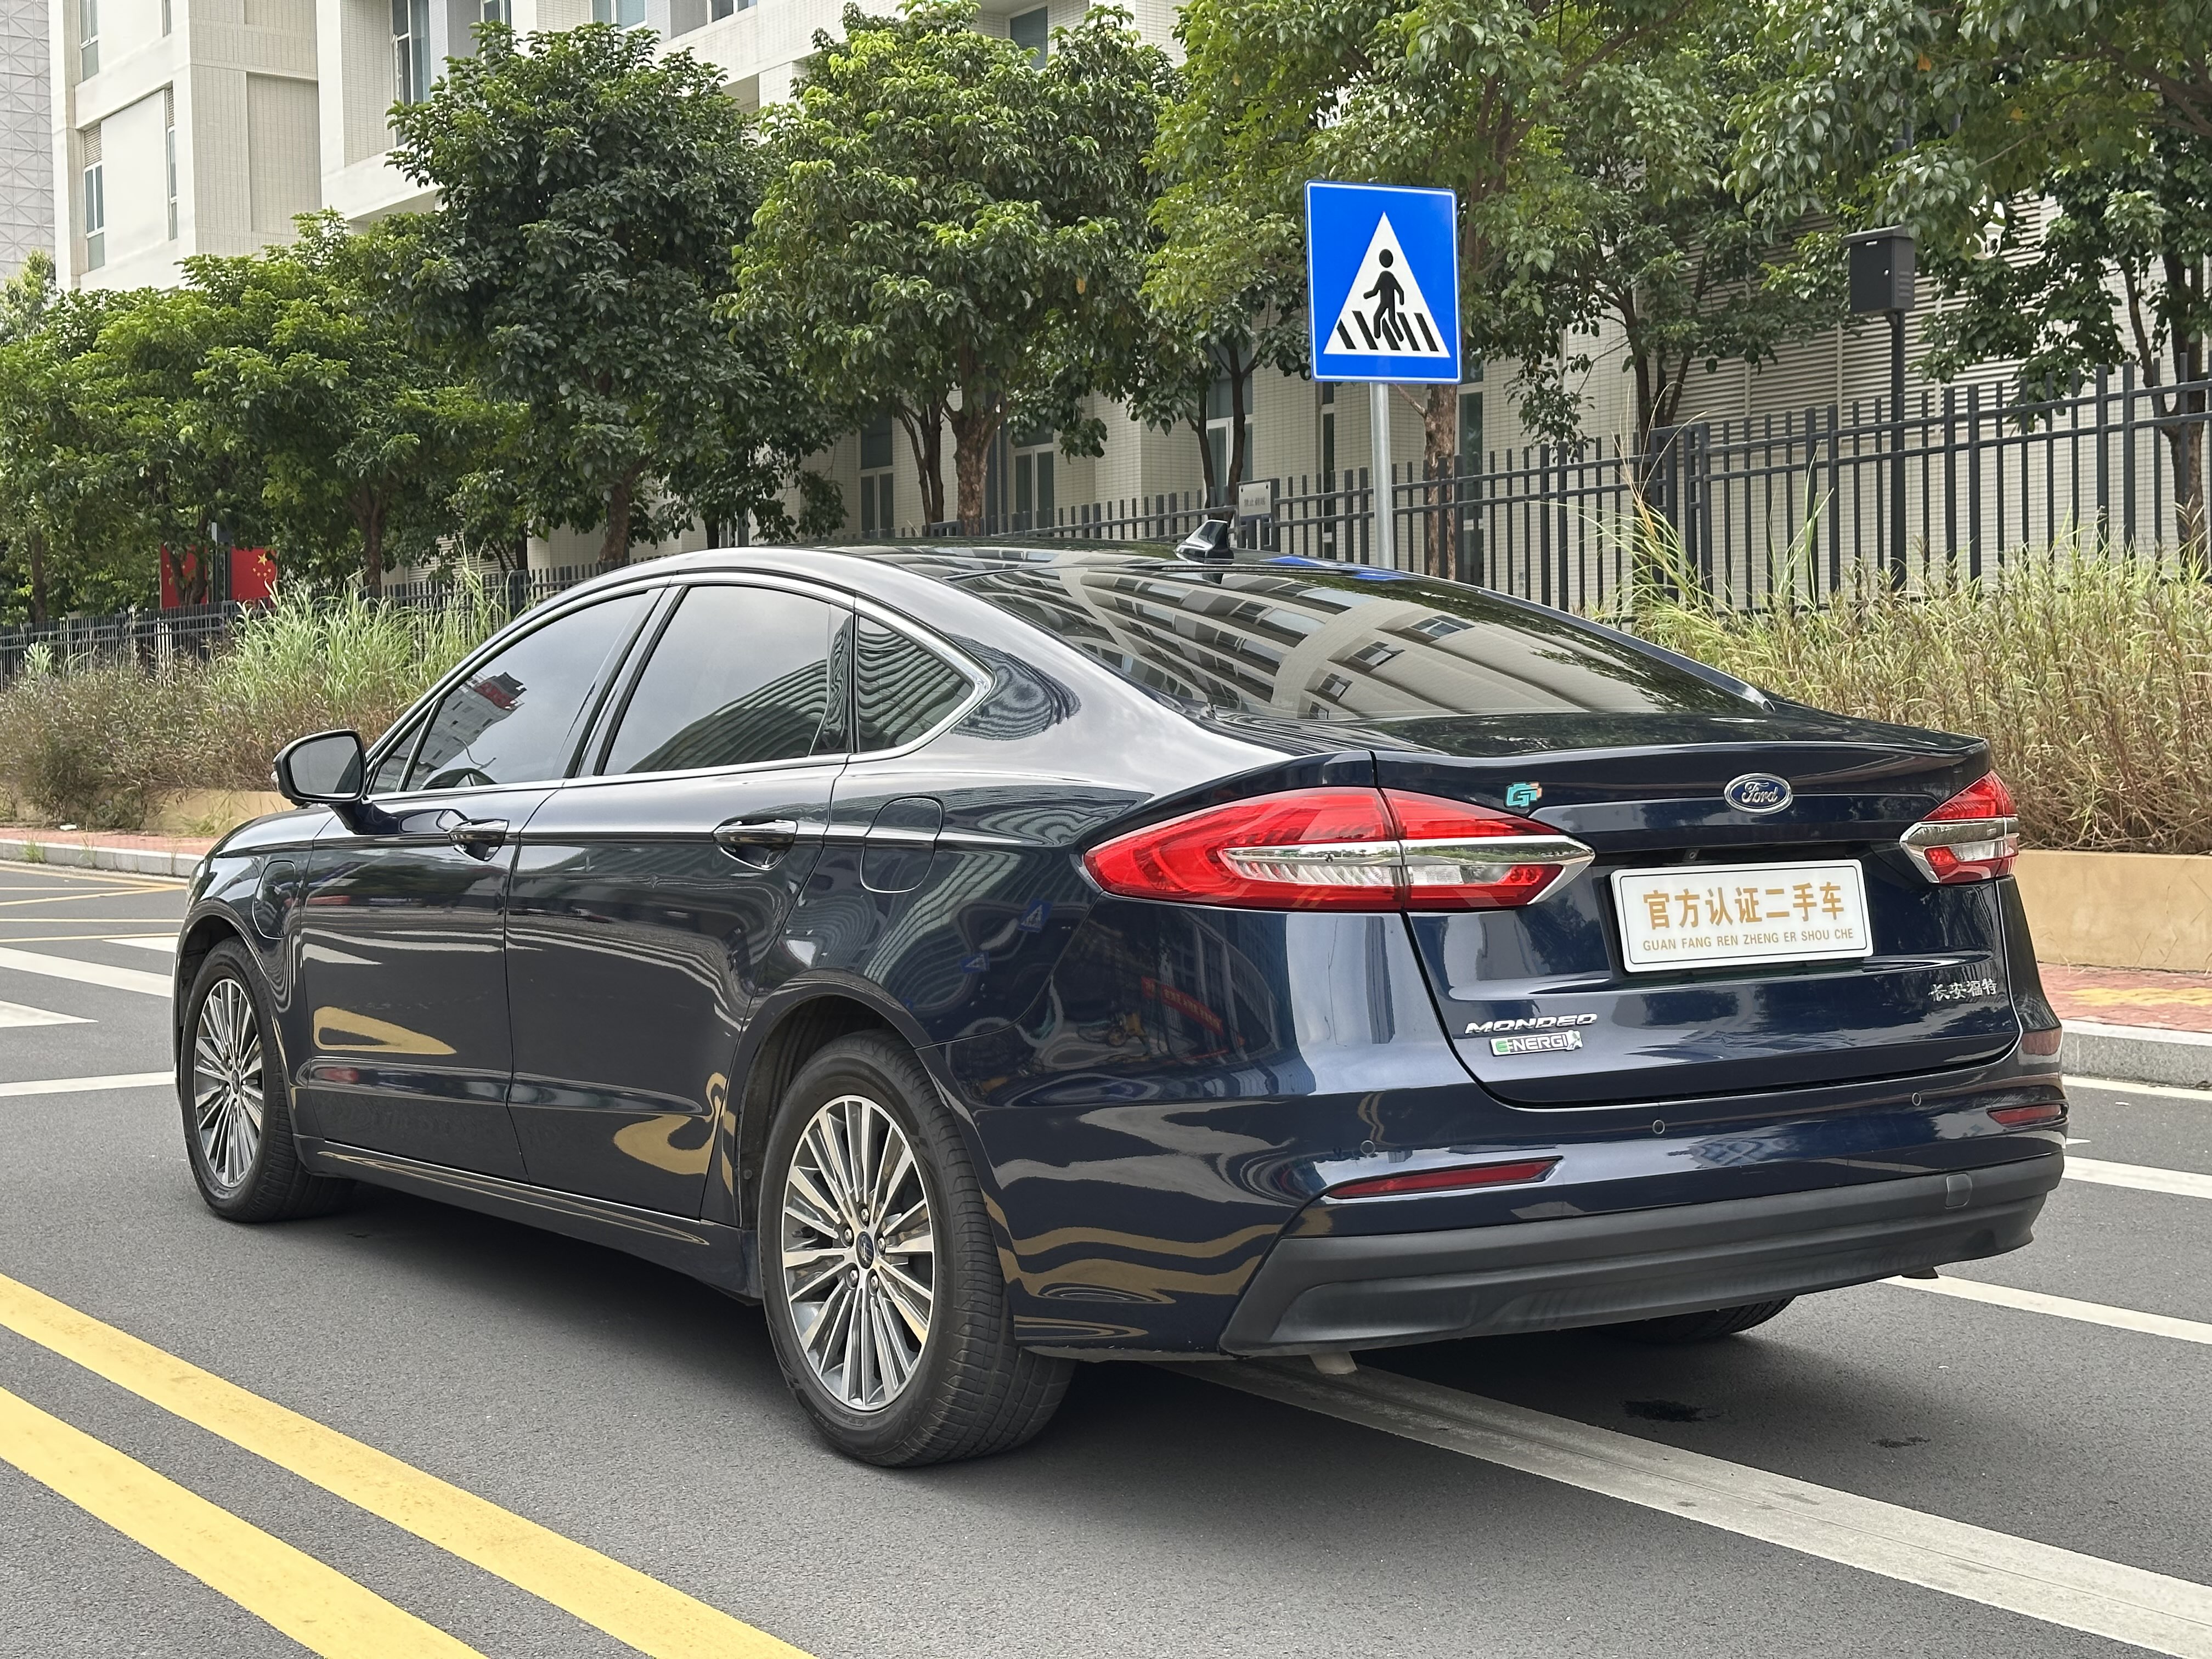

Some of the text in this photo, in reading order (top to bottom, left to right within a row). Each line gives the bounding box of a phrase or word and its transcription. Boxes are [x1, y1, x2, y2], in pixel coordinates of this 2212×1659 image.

[1741, 781, 1779, 803] Ford
[1643, 881, 1845, 929] 官方认证二手车
[1643, 928, 1853, 951] GUAN FANG REN ZHENG ER SHOU CHE
[1929, 978, 1996, 1001] 长安福特
[1465, 1013, 1598, 1034] MONDEO
